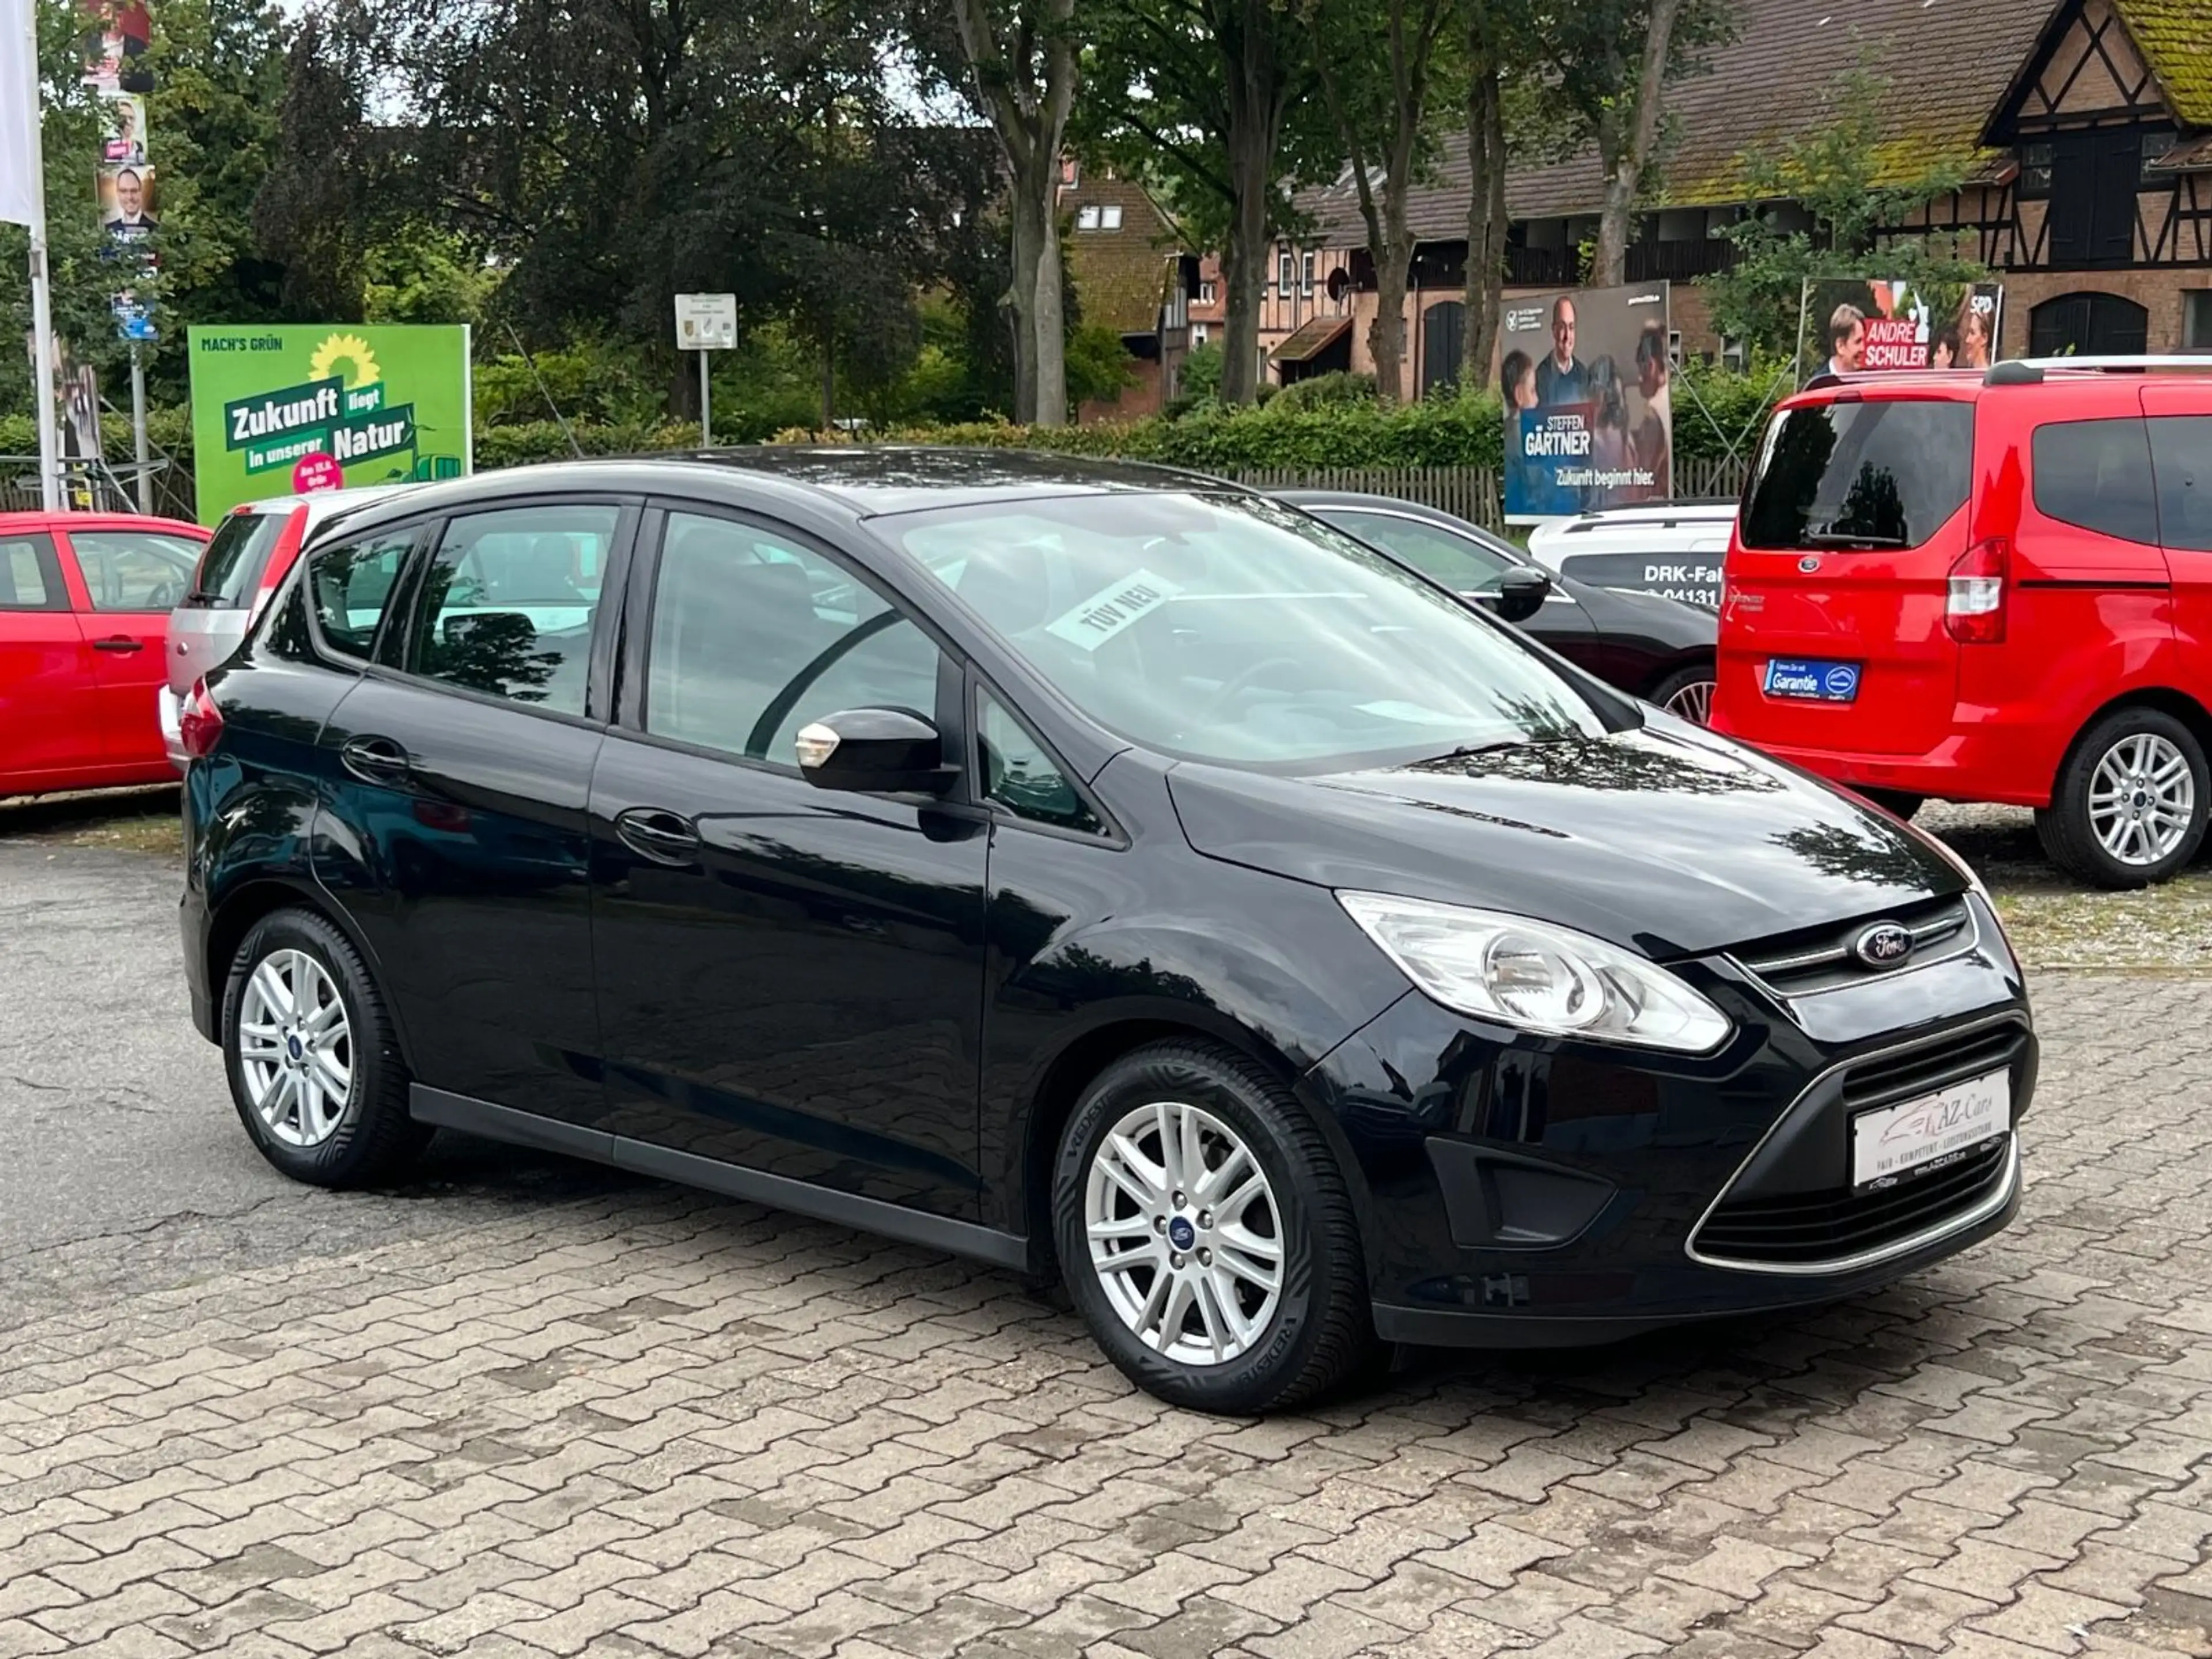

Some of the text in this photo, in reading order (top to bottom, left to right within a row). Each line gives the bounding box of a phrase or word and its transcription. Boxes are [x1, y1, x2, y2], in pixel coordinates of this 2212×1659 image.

[1970, 295, 1993, 314] SPD
[201, 334, 283, 351] MACH'S GRÜN
[1865, 345, 1927, 366] SCHULER
[232, 388, 380, 441] Zukunft liegt
[1547, 415, 1585, 431] STEFFEN
[249, 421, 406, 468] in unserer Natur
[1525, 425, 1590, 456] GÄRTNER
[1555, 467, 1655, 490] Zukunft beginnt hier.
[1079, 584, 1161, 632] TÜV NEU
[1772, 672, 1818, 691] Garantie
[1875, 929, 1907, 957] Ford
